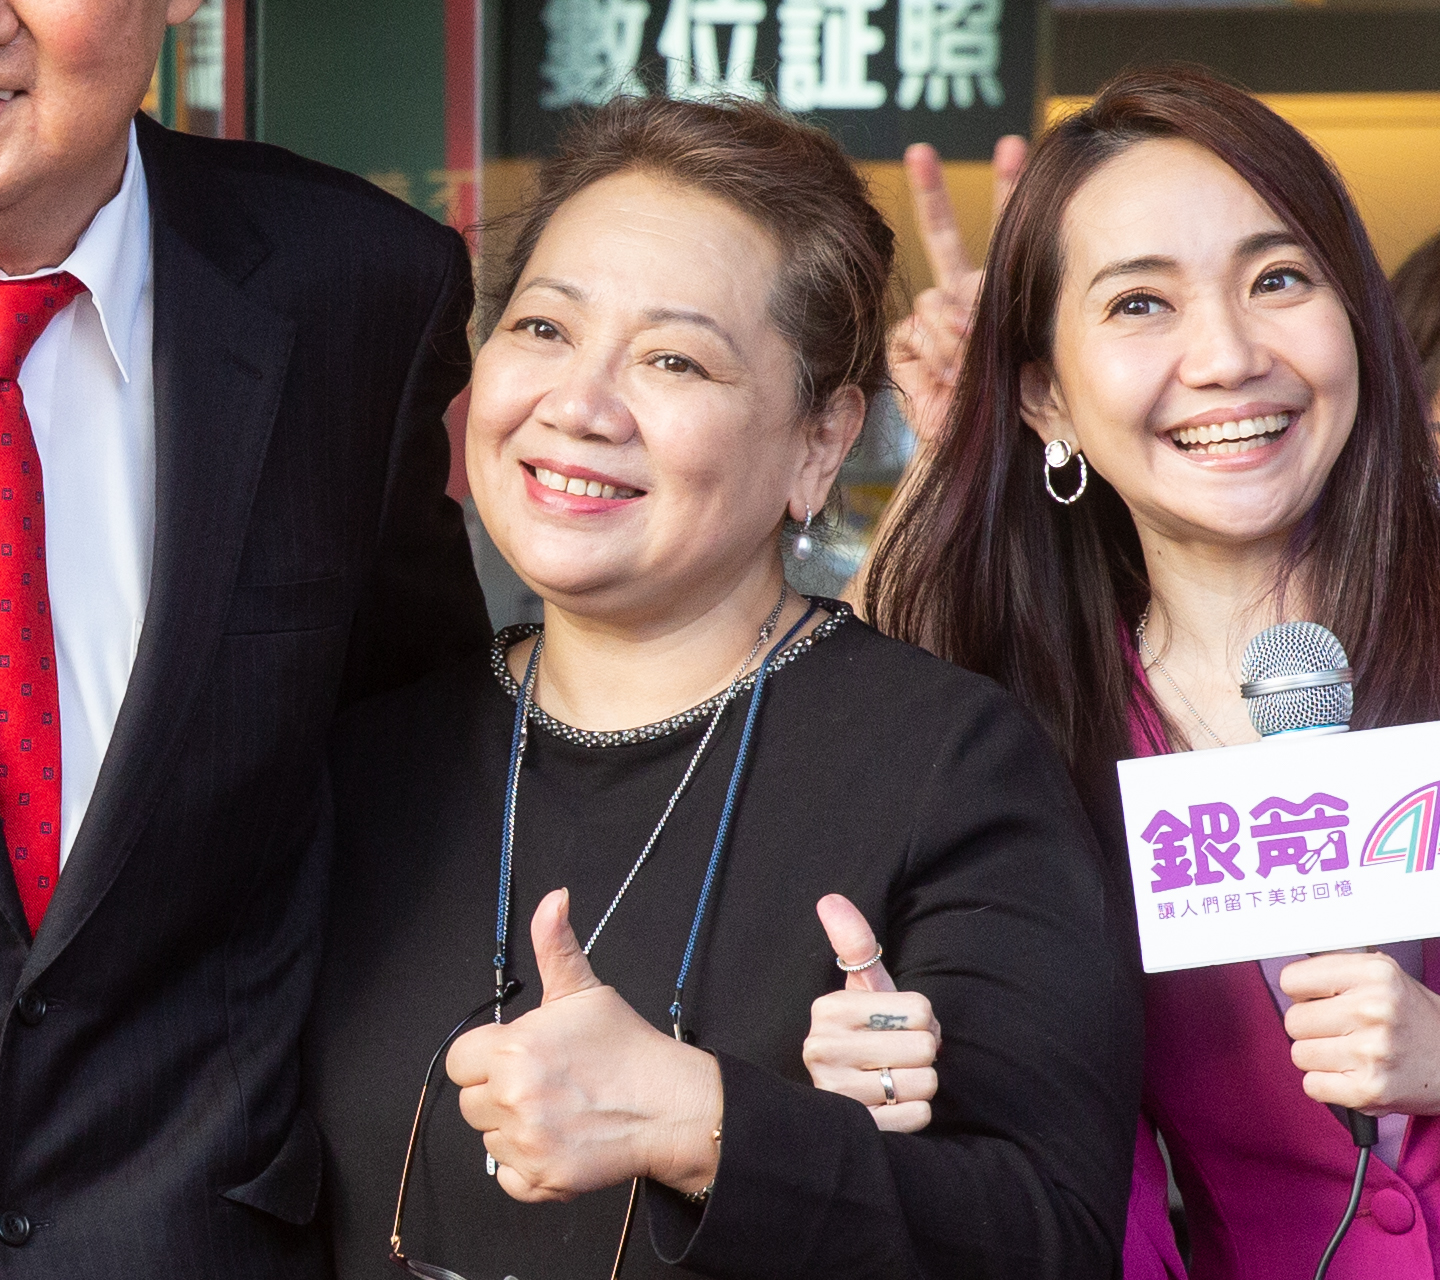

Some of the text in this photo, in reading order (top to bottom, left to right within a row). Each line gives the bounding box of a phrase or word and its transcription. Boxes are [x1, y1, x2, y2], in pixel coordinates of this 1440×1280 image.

[1139, 791, 1350, 893] 銀箭
[1156, 879, 1354, 920] 讓人們留下美好回憶
